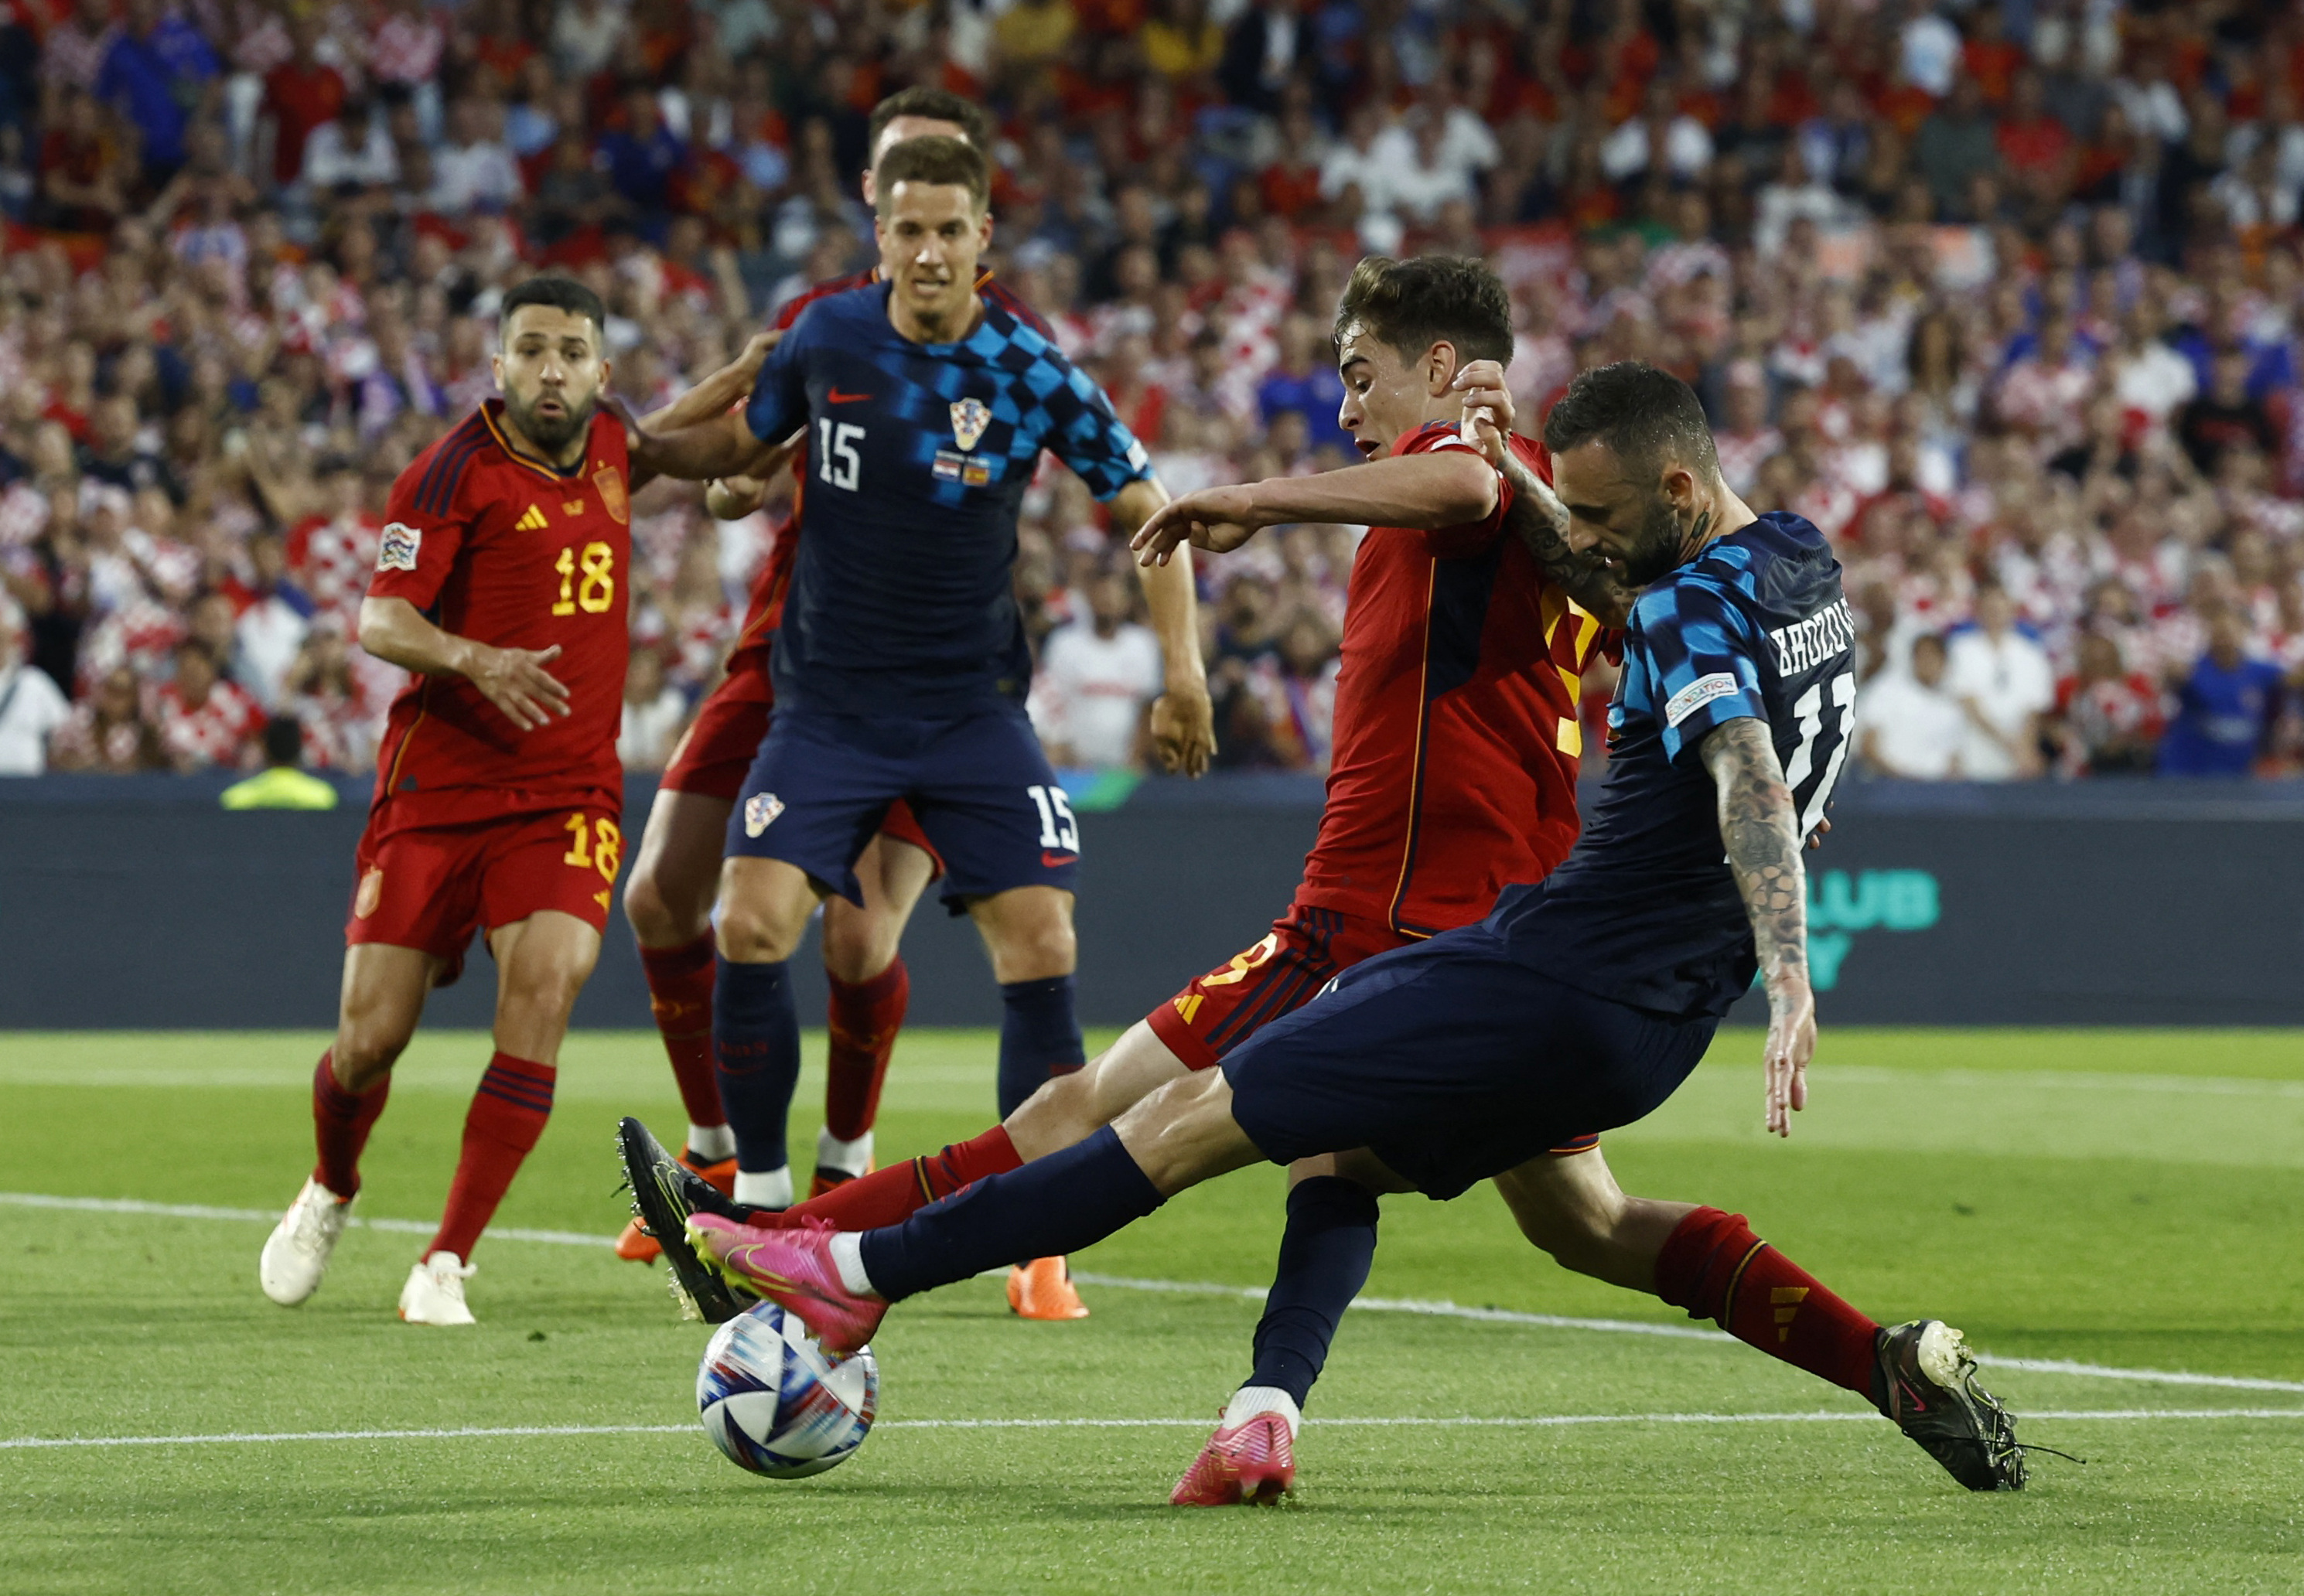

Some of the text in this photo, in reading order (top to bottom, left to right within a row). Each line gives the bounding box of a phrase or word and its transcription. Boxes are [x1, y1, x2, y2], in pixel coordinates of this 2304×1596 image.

[819, 418, 865, 492] 15
[552, 541, 614, 616] 18
[1770, 592, 1855, 677] BROZOV
[563, 813, 620, 885] 18
[1027, 786, 1080, 853] 15
